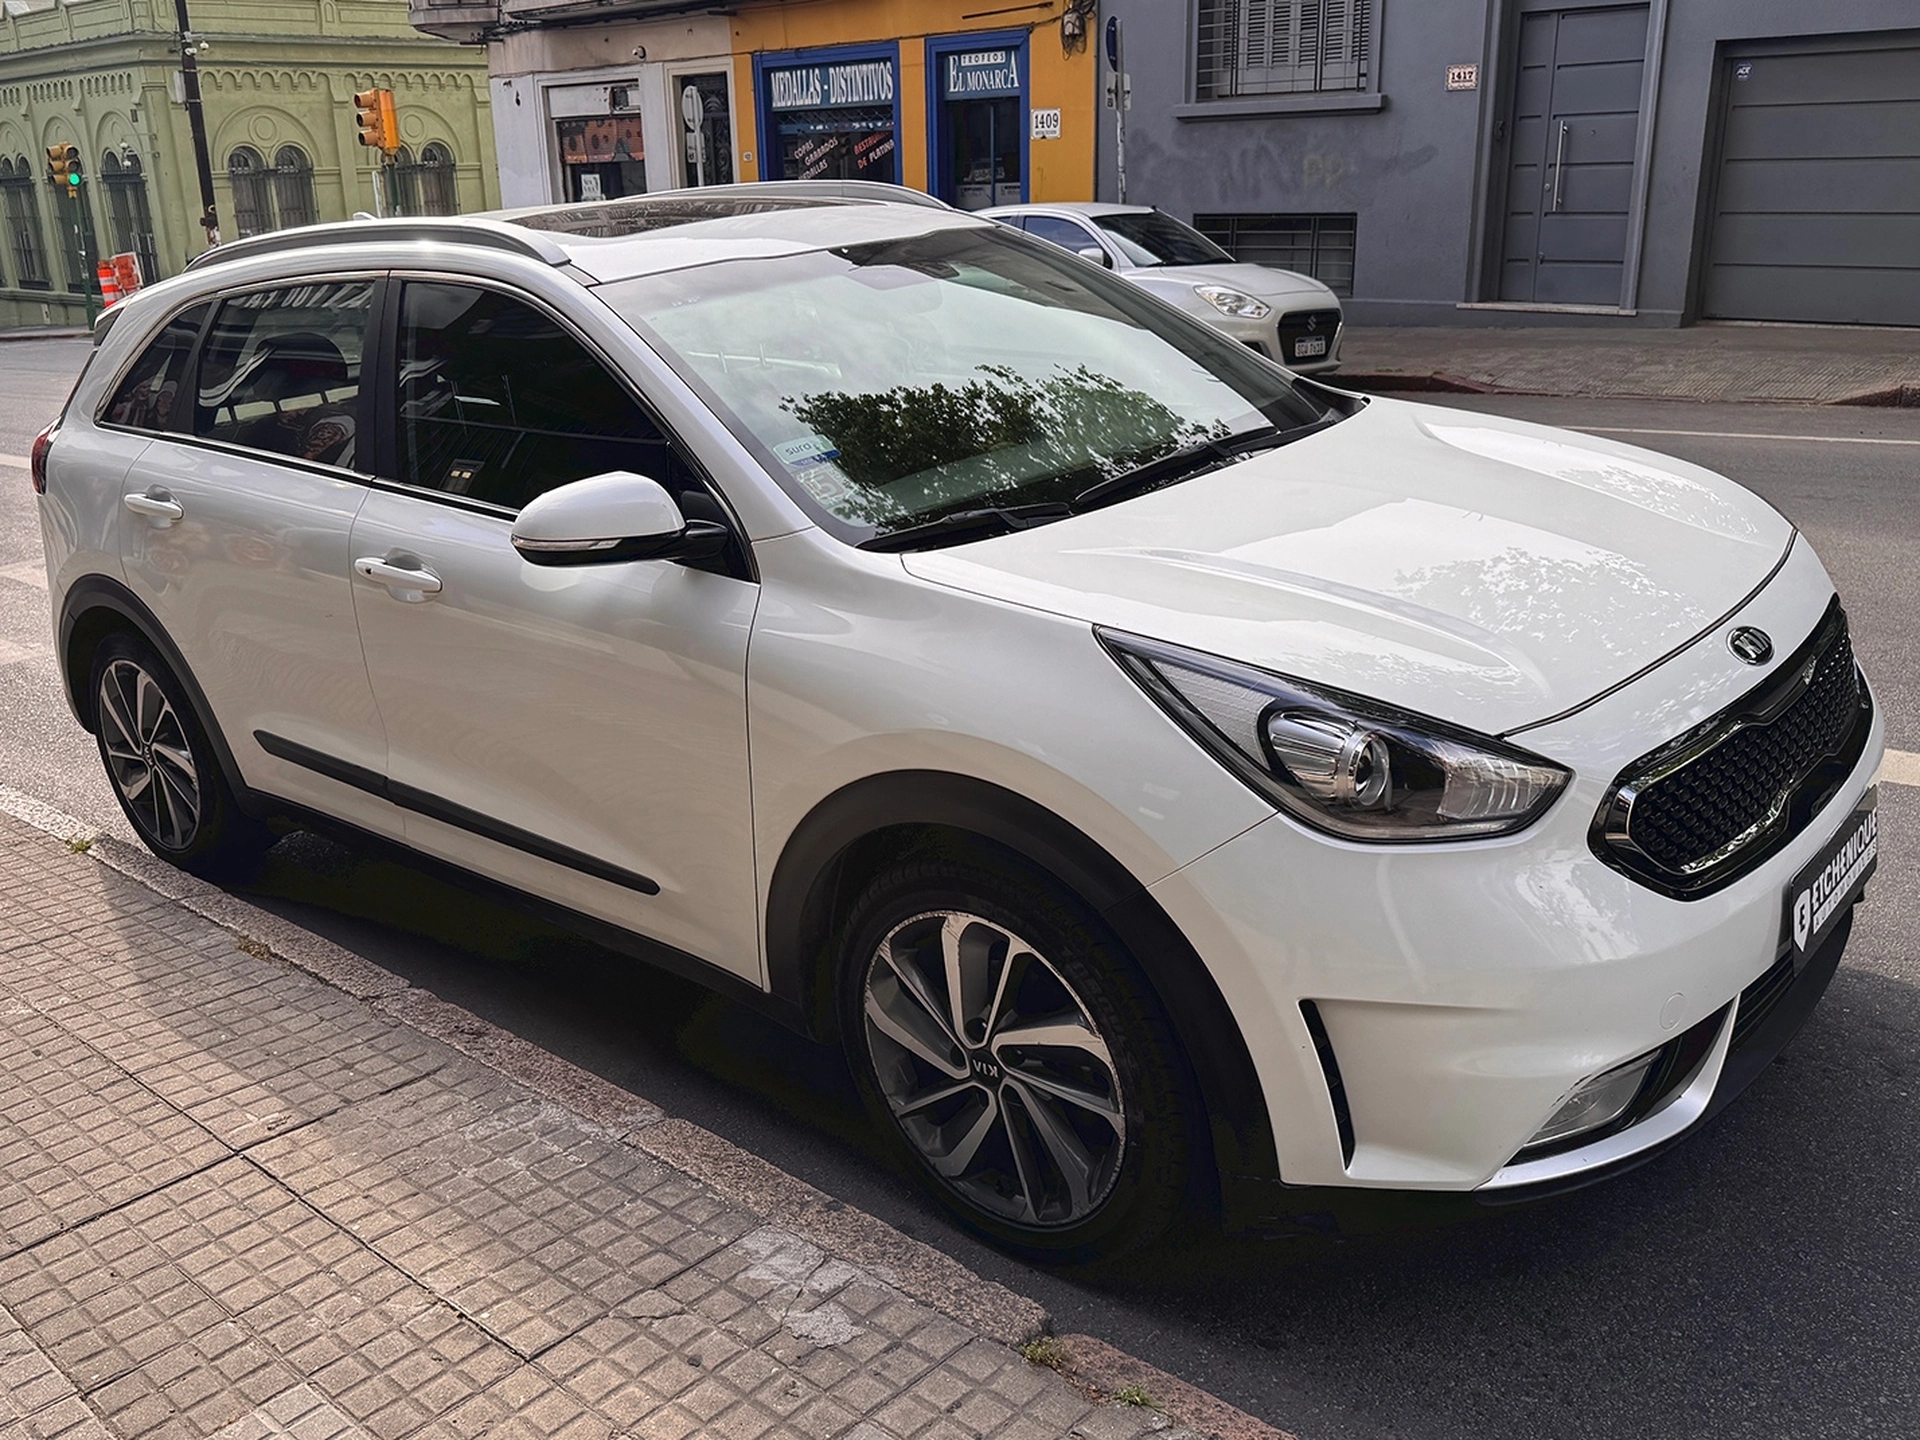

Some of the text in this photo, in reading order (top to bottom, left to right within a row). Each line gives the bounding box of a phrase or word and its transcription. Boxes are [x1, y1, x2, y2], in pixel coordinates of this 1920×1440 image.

[962, 52, 1005, 65] TROFEOS
[1451, 71, 1474, 80] 1417
[771, 68, 821, 107] MEDALLAS
[829, 61, 894, 104] DISTINTIVOS
[1034, 112, 1059, 129] 1409
[794, 140, 815, 159] COPAS
[857, 157, 868, 169] DE
[785, 442, 812, 456] sura
[972, 1058, 999, 1078] KIA
